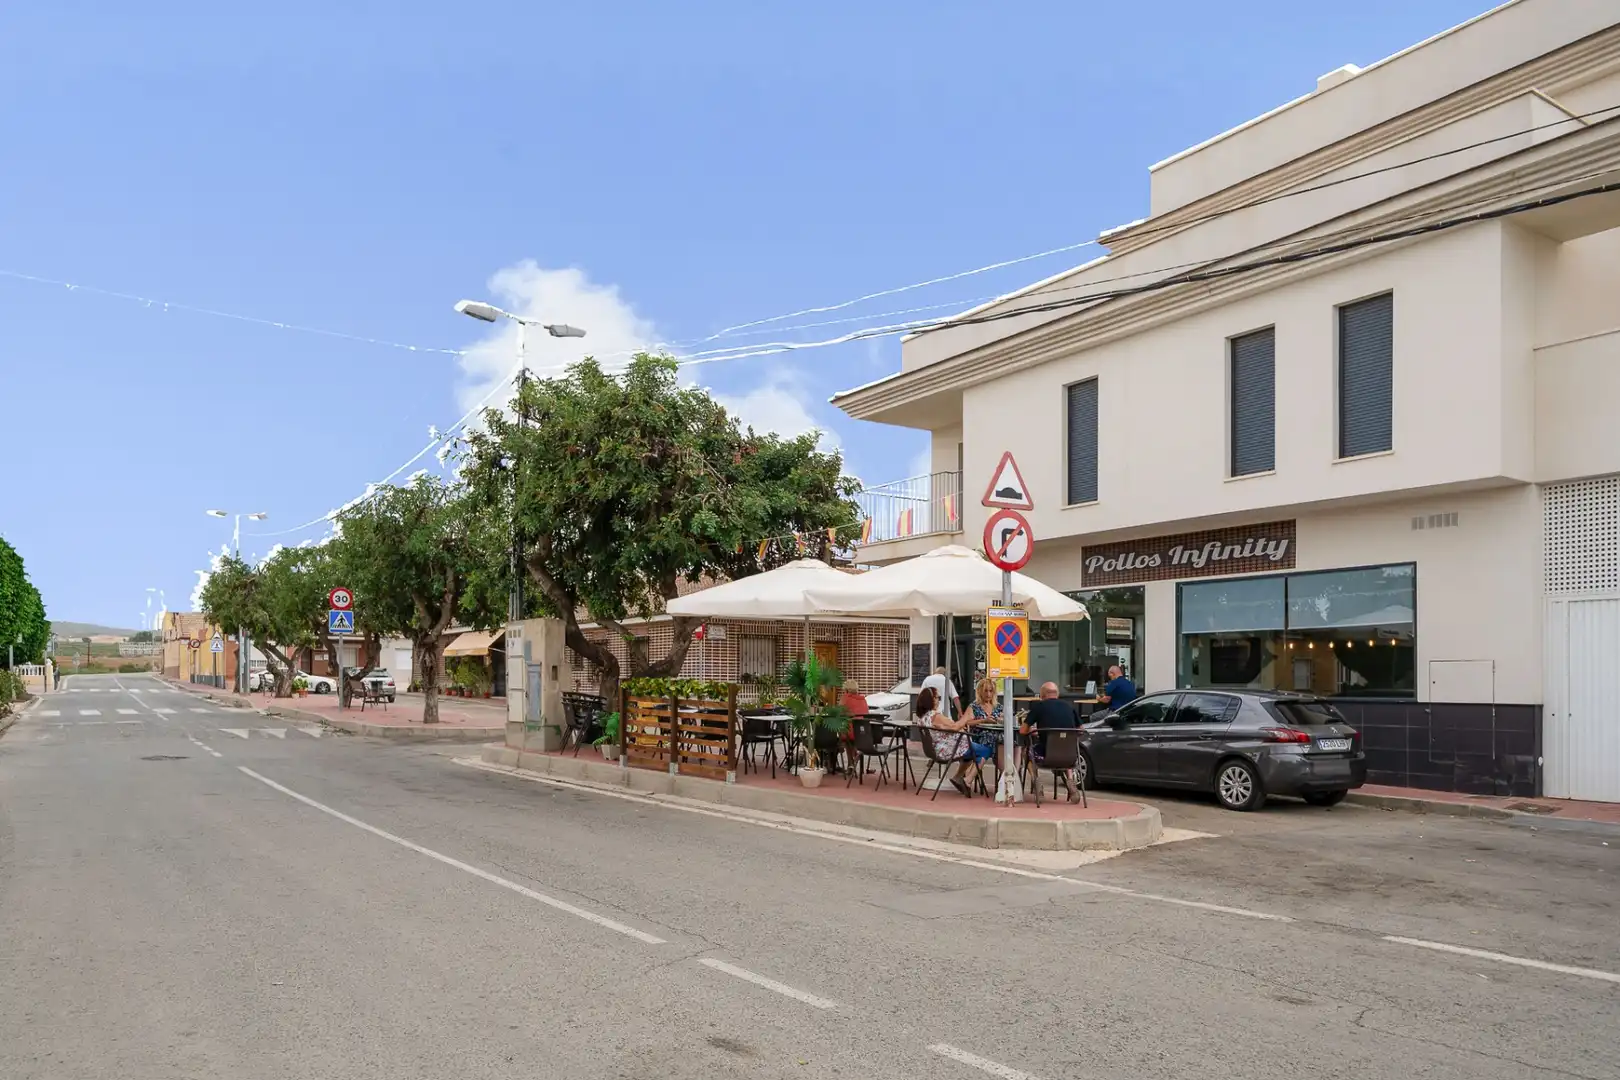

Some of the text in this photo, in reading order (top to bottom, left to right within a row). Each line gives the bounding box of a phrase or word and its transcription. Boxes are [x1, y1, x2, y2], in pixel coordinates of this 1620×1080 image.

[1085, 537, 1289, 574] Pollos Infinity
[334, 595, 348, 603] 30
